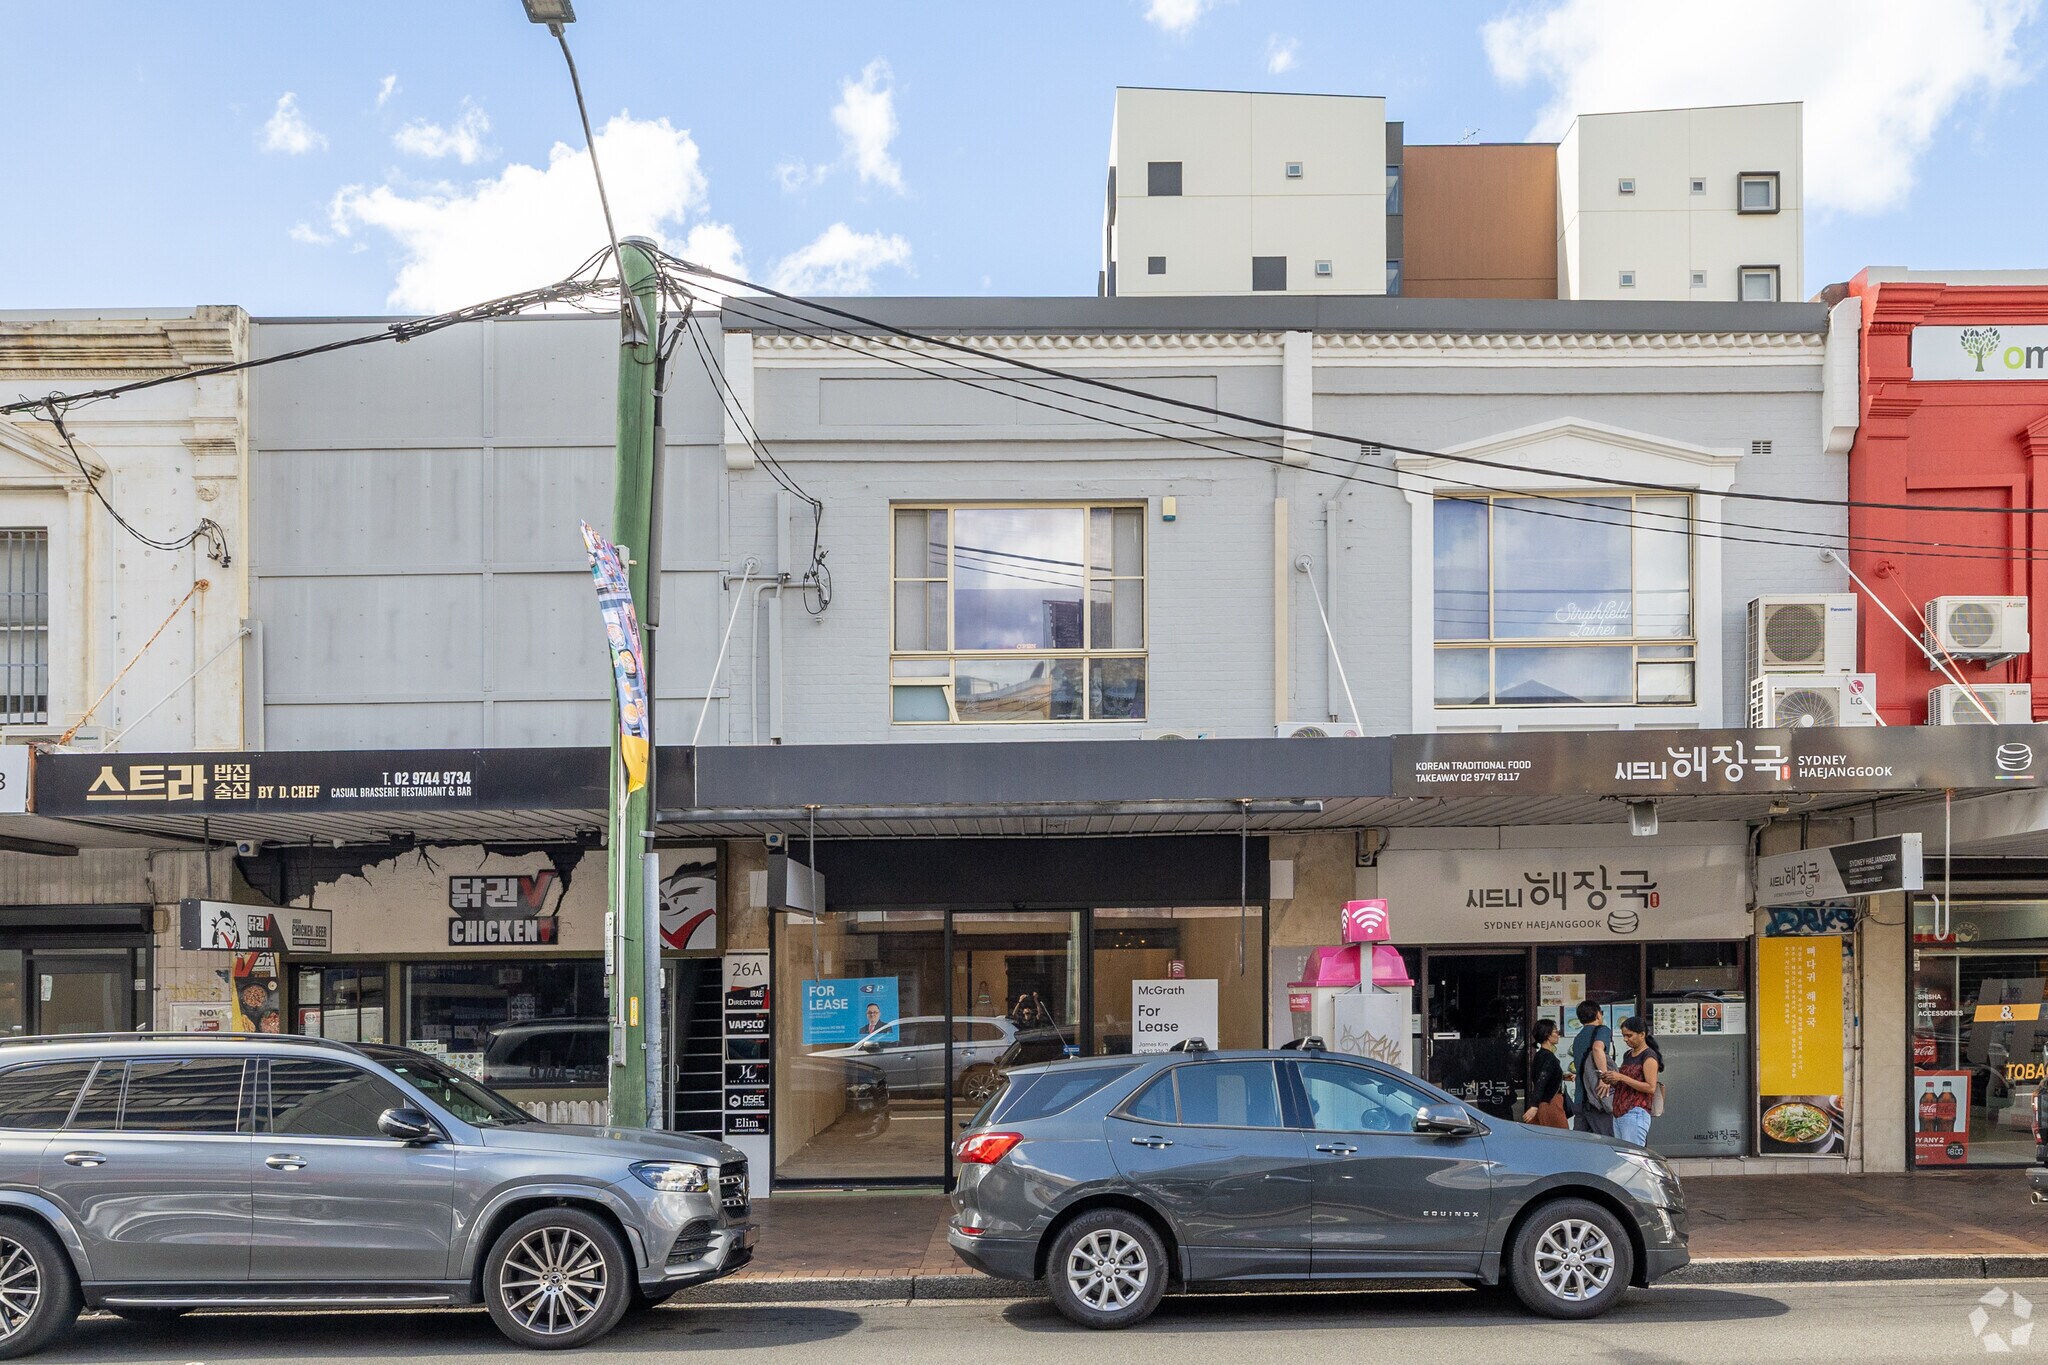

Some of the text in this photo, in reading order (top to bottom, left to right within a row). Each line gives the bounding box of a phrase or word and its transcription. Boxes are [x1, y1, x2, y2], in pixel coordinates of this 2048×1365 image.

[1555, 600, 1632, 622] Strathfield
[1569, 620, 1616, 637] Lashes
[1850, 697, 1862, 705] LG
[1415, 760, 1531, 771] KOREAN TRADITIONAL FOOD
[1798, 755, 1847, 766] SYDNEY
[214, 764, 251, 781] 밥집
[382, 771, 471, 785] T. 02 9744 9734
[1415, 773, 1520, 783] TAKEAWAY 02 9747 8117
[1799, 766, 1893, 779] HAEJANGGOOK
[86, 764, 208, 801] 스트라
[214, 782, 251, 800] 술집
[258, 786, 274, 799] BY
[331, 786, 472, 798] CASUAL BRASSERIE RESTAURANT & BAR
[1849, 854, 1897, 868] SYDNEY HAEJANGGOOK
[1484, 920, 1602, 931] SYDNEY HAEJANGGOOK
[732, 962, 763, 977] 26A
[809, 986, 835, 997] FOR
[1138, 986, 1185, 995] McGrath
[809, 999, 849, 1011] LEASE
[1138, 1005, 1161, 1017] For
[1806, 990, 1817, 1029] 해장국
[2001, 1005, 2014, 1020] &
[728, 1020, 765, 1029] VAPSCO
[1138, 1020, 1179, 1032] Lease
[743, 1095, 765, 1103] OSEC
[735, 1118, 759, 1127] Elim
